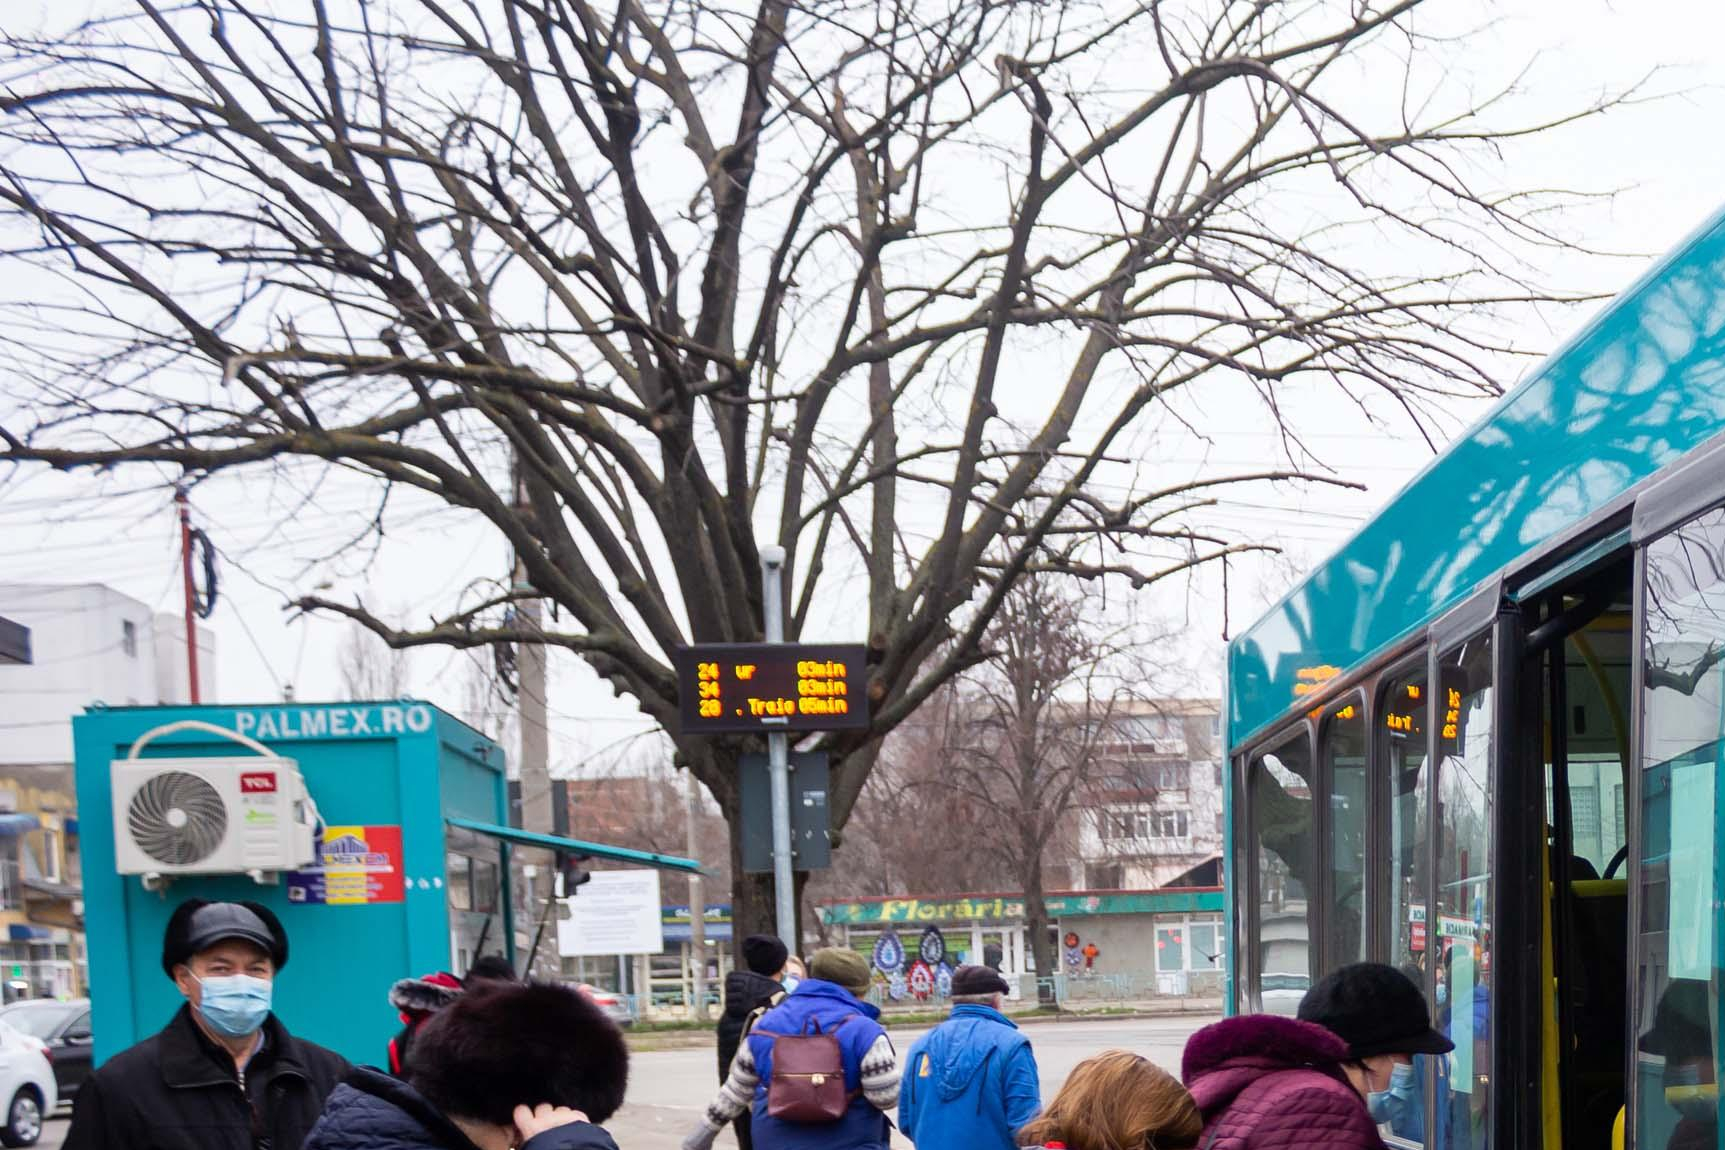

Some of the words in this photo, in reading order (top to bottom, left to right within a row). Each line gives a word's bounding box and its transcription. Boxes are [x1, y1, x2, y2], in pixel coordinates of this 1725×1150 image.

[698, 662, 719, 680] 24
[698, 681, 720, 698] 34
[235, 705, 432, 739] PALMEX.RO
